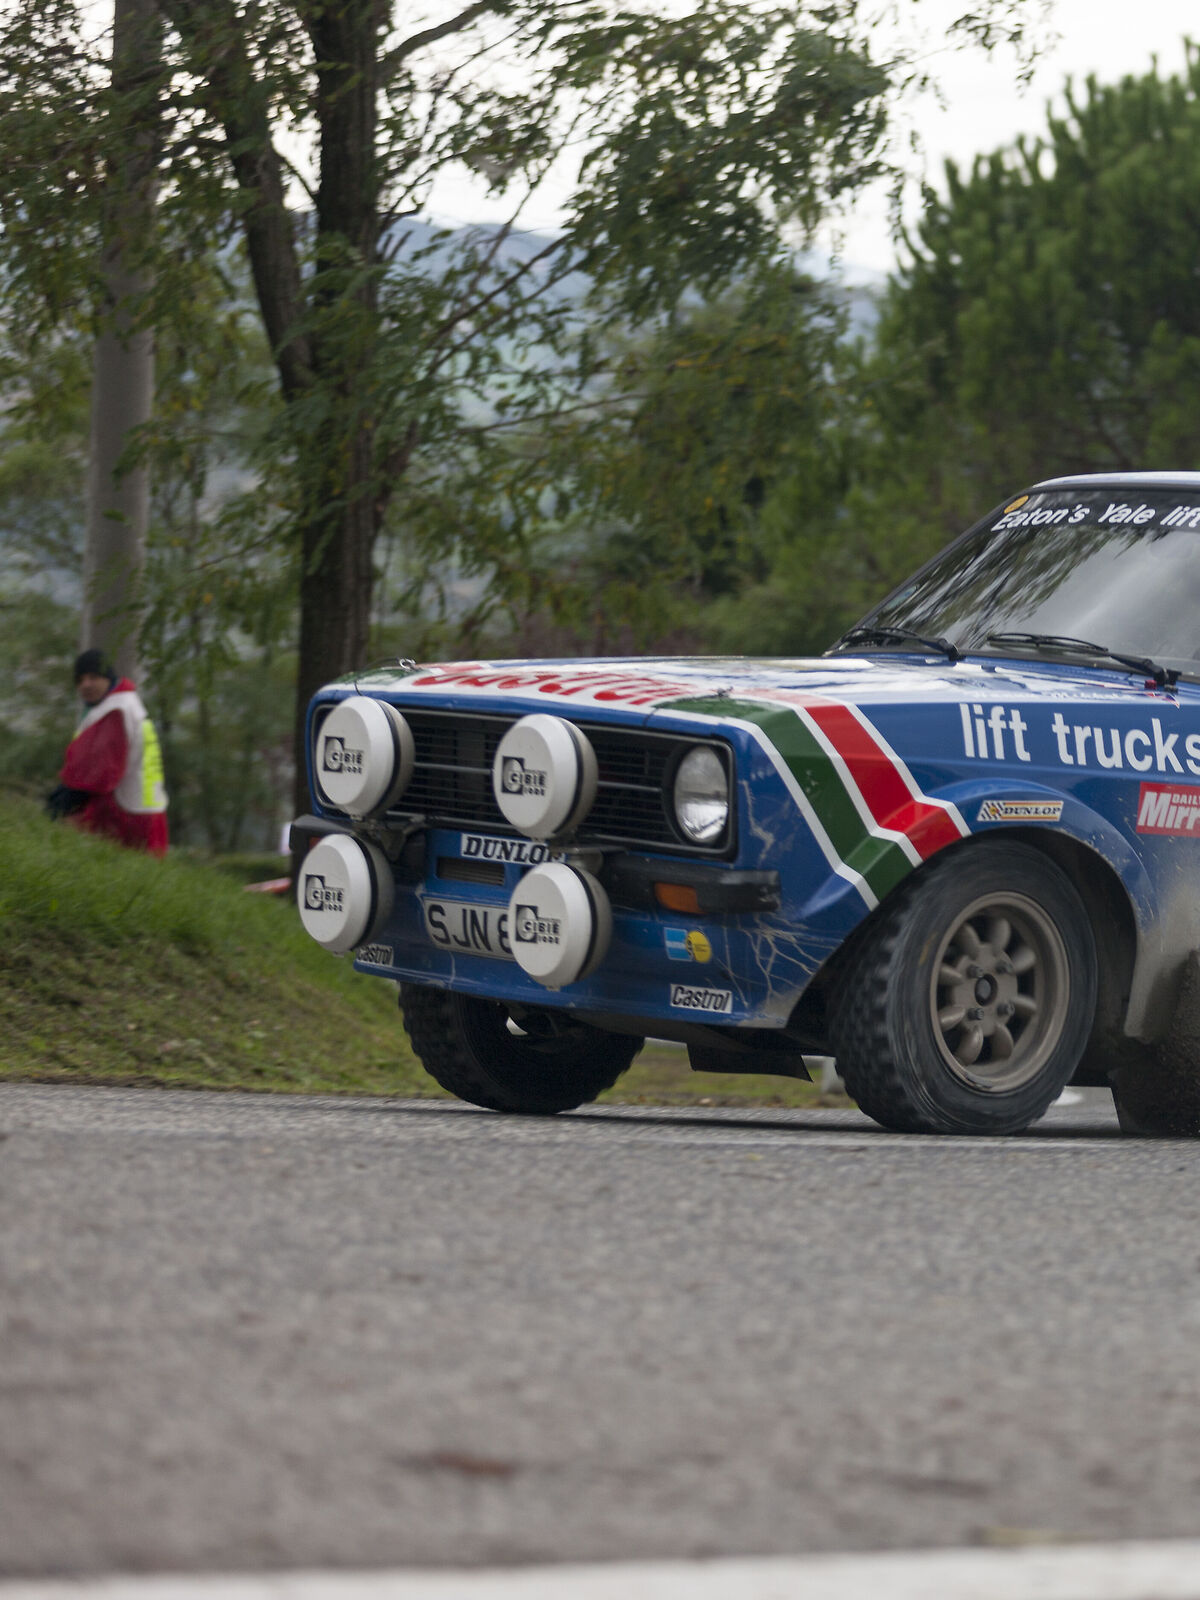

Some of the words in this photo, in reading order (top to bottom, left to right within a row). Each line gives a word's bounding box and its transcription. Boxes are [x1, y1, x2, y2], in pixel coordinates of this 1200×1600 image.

[991, 504, 1090, 532] Eaton's
[1098, 503, 1156, 526] Yale
[959, 703, 1031, 762] lift
[1003, 806, 1061, 815] DUNLOP
[463, 836, 559, 863] DUNLO
[428, 904, 493, 952] SJN
[671, 985, 731, 1011] Castrol
